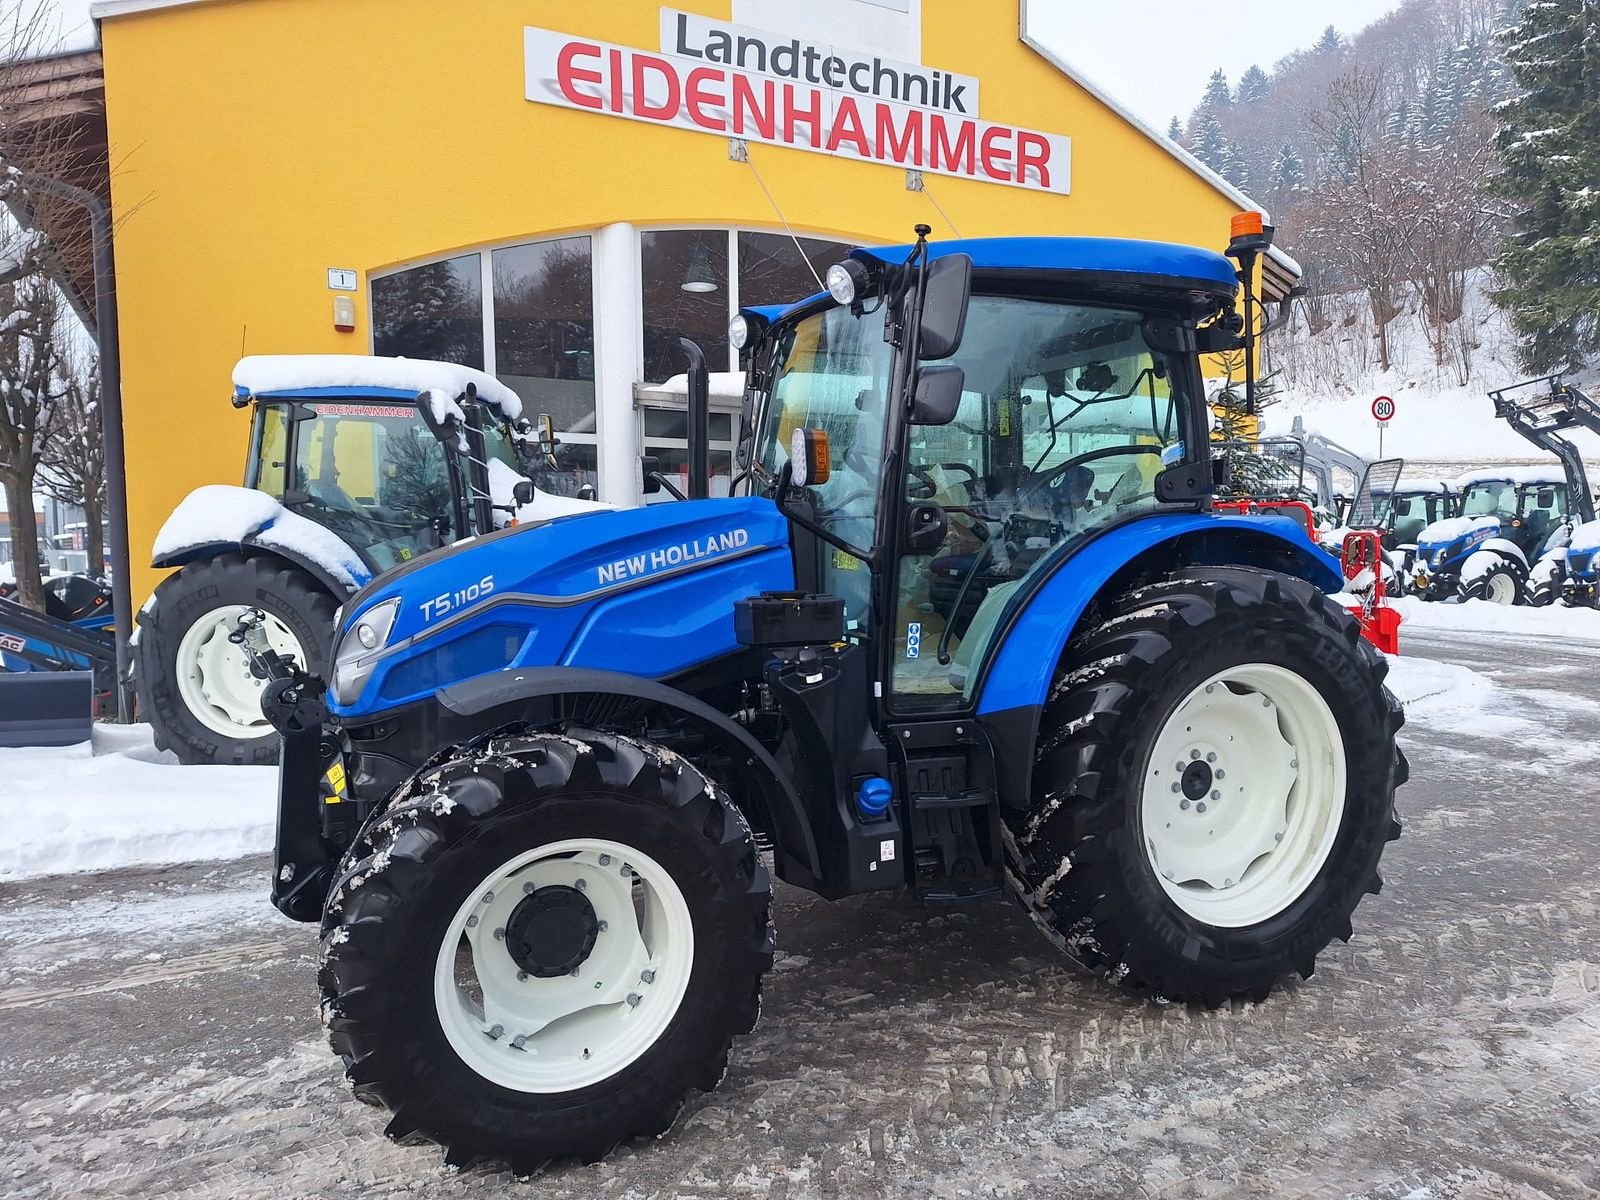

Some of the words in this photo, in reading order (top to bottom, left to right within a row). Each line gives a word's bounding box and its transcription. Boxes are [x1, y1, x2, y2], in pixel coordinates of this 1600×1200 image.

[676, 13, 967, 113] Landtechnik
[557, 41, 1051, 188] EIDENHAMMER
[316, 404, 413, 417] EIDENHAMMER
[1377, 402, 1390, 415] 80
[597, 555, 646, 584] NEW
[650, 528, 748, 570] HOLLAND
[419, 574, 494, 622] T5.110S
